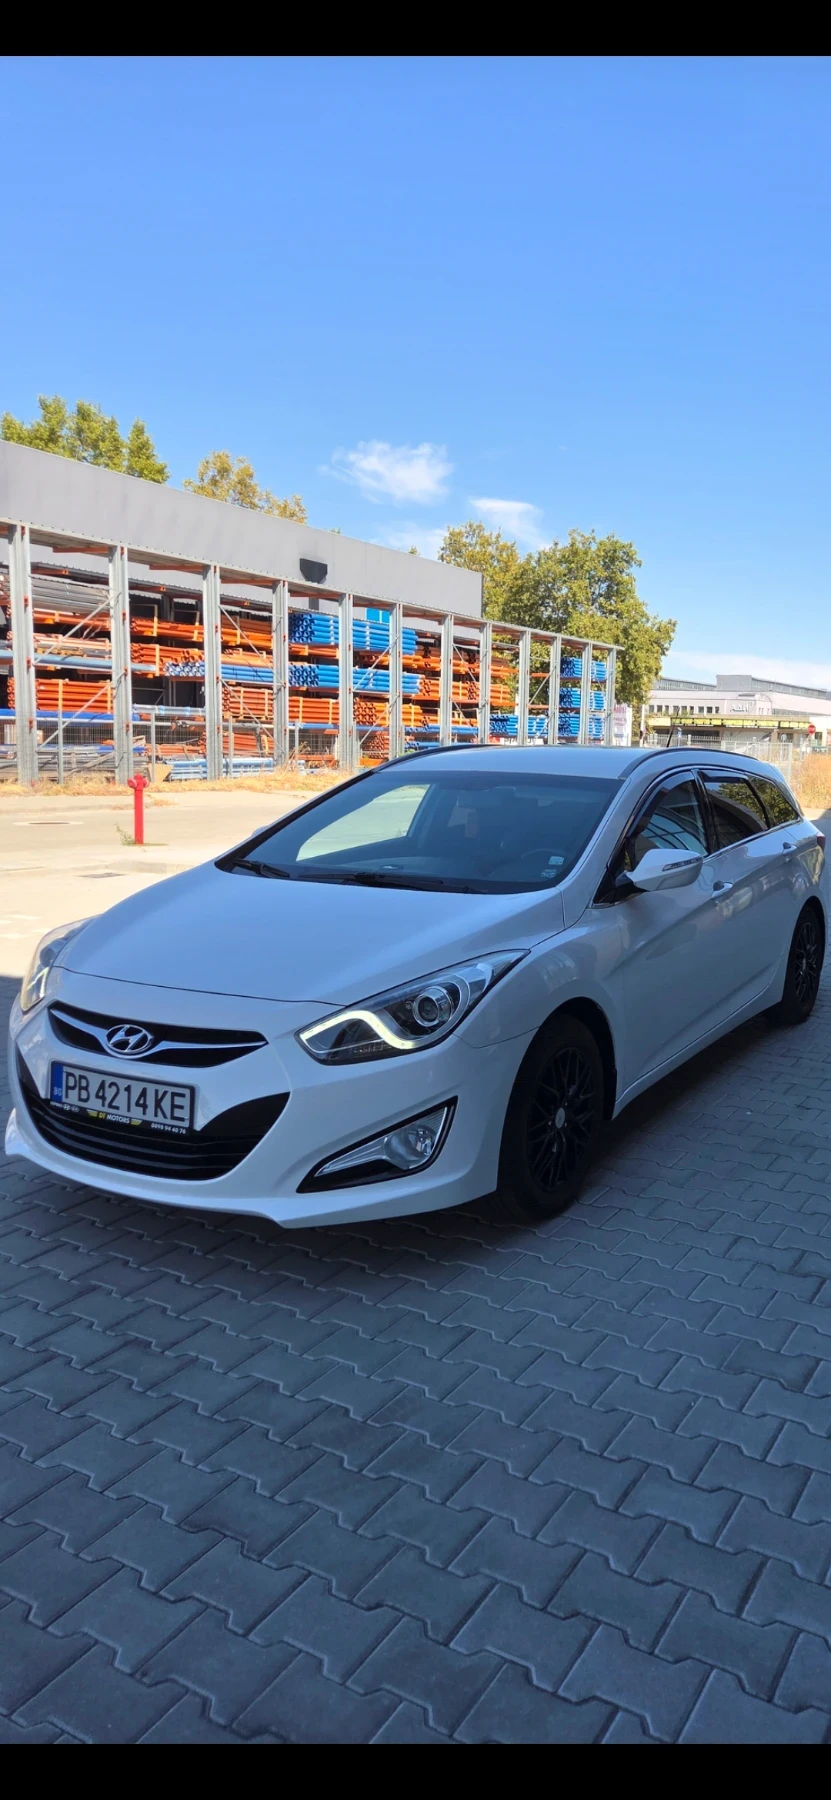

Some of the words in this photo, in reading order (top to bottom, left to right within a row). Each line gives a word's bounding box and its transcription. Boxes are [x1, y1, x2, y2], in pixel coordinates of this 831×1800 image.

[53, 1086, 62, 1096] BG
[65, 1071, 90, 1103] PB
[95, 1079, 148, 1116] 4214
[154, 1088, 187, 1122] KE
[106, 1114, 130, 1124] MOTORS
